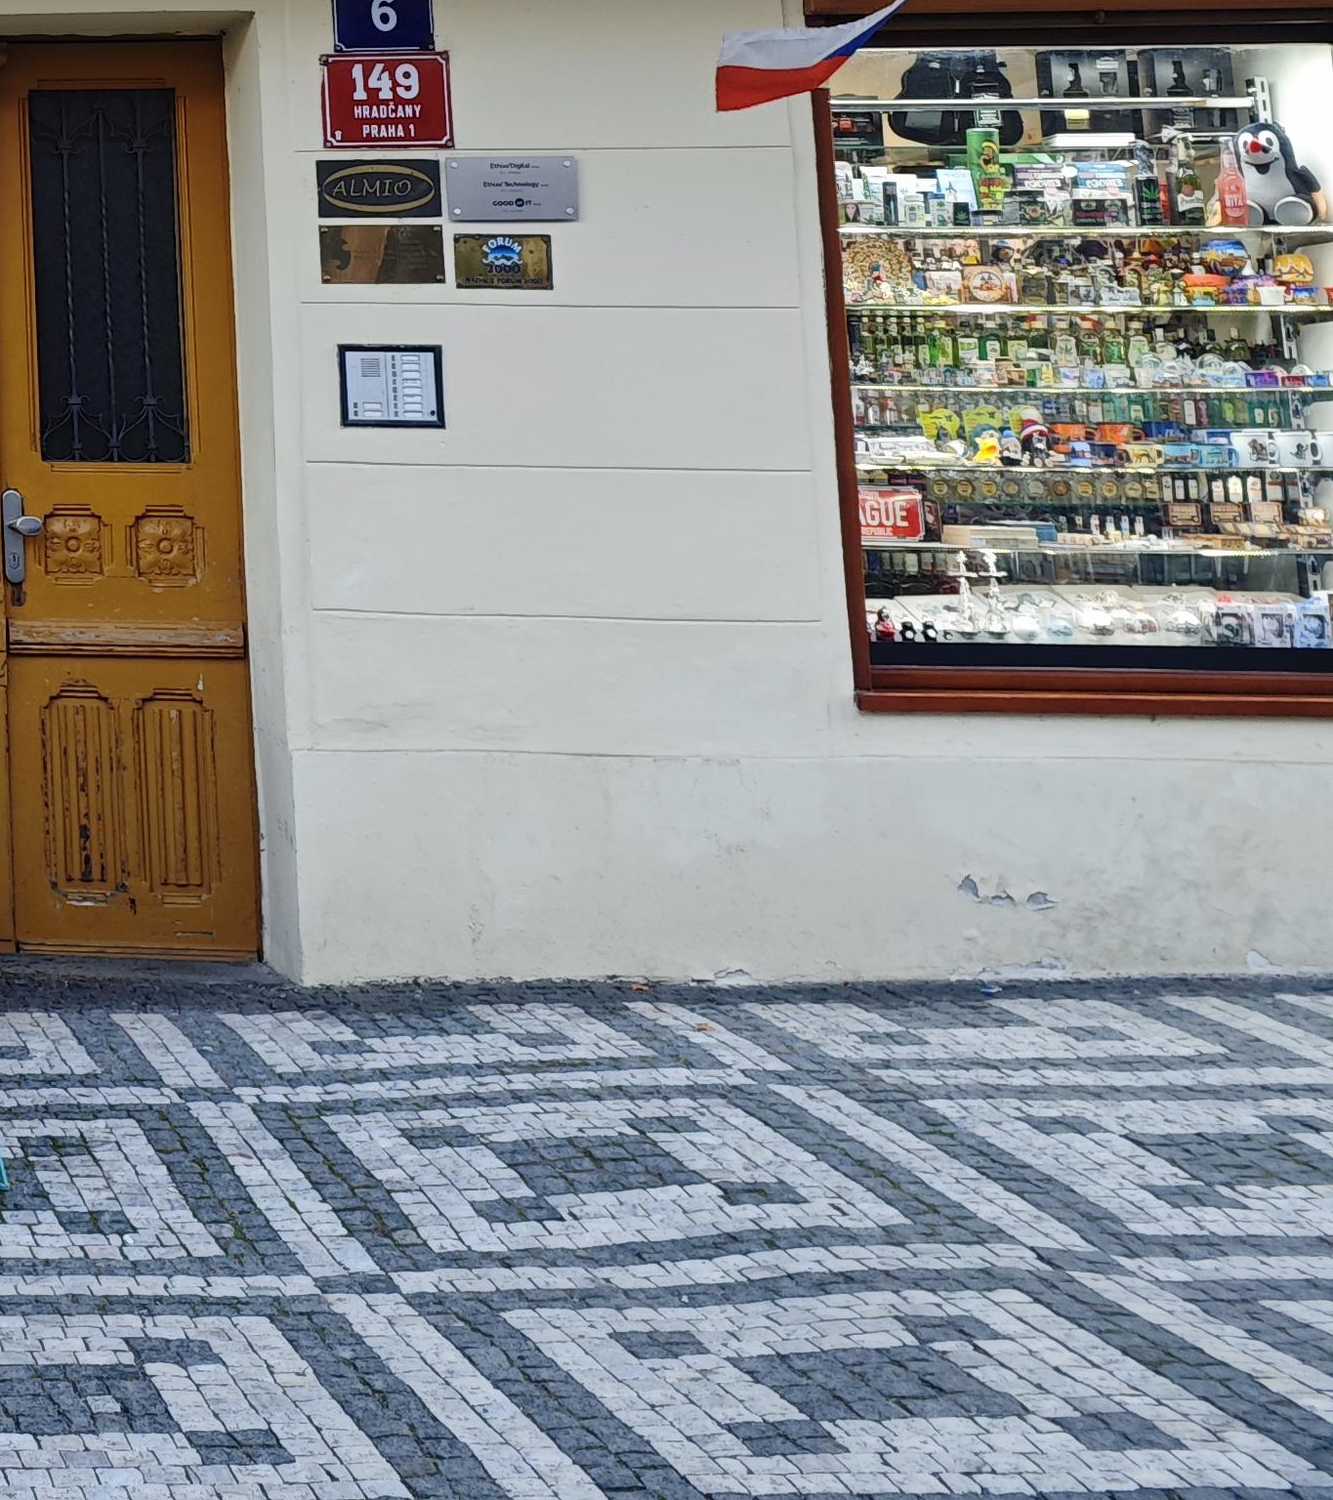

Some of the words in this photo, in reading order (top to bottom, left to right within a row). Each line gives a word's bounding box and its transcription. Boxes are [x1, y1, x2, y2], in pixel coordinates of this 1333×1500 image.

[351, 62, 421, 100] 149
[354, 102, 422, 120] HRADČANY
[362, 123, 406, 139] PRAHA
[408, 123, 415, 137] 1
[333, 178, 411, 197] ALMIO
[481, 236, 523, 254] FORUM
